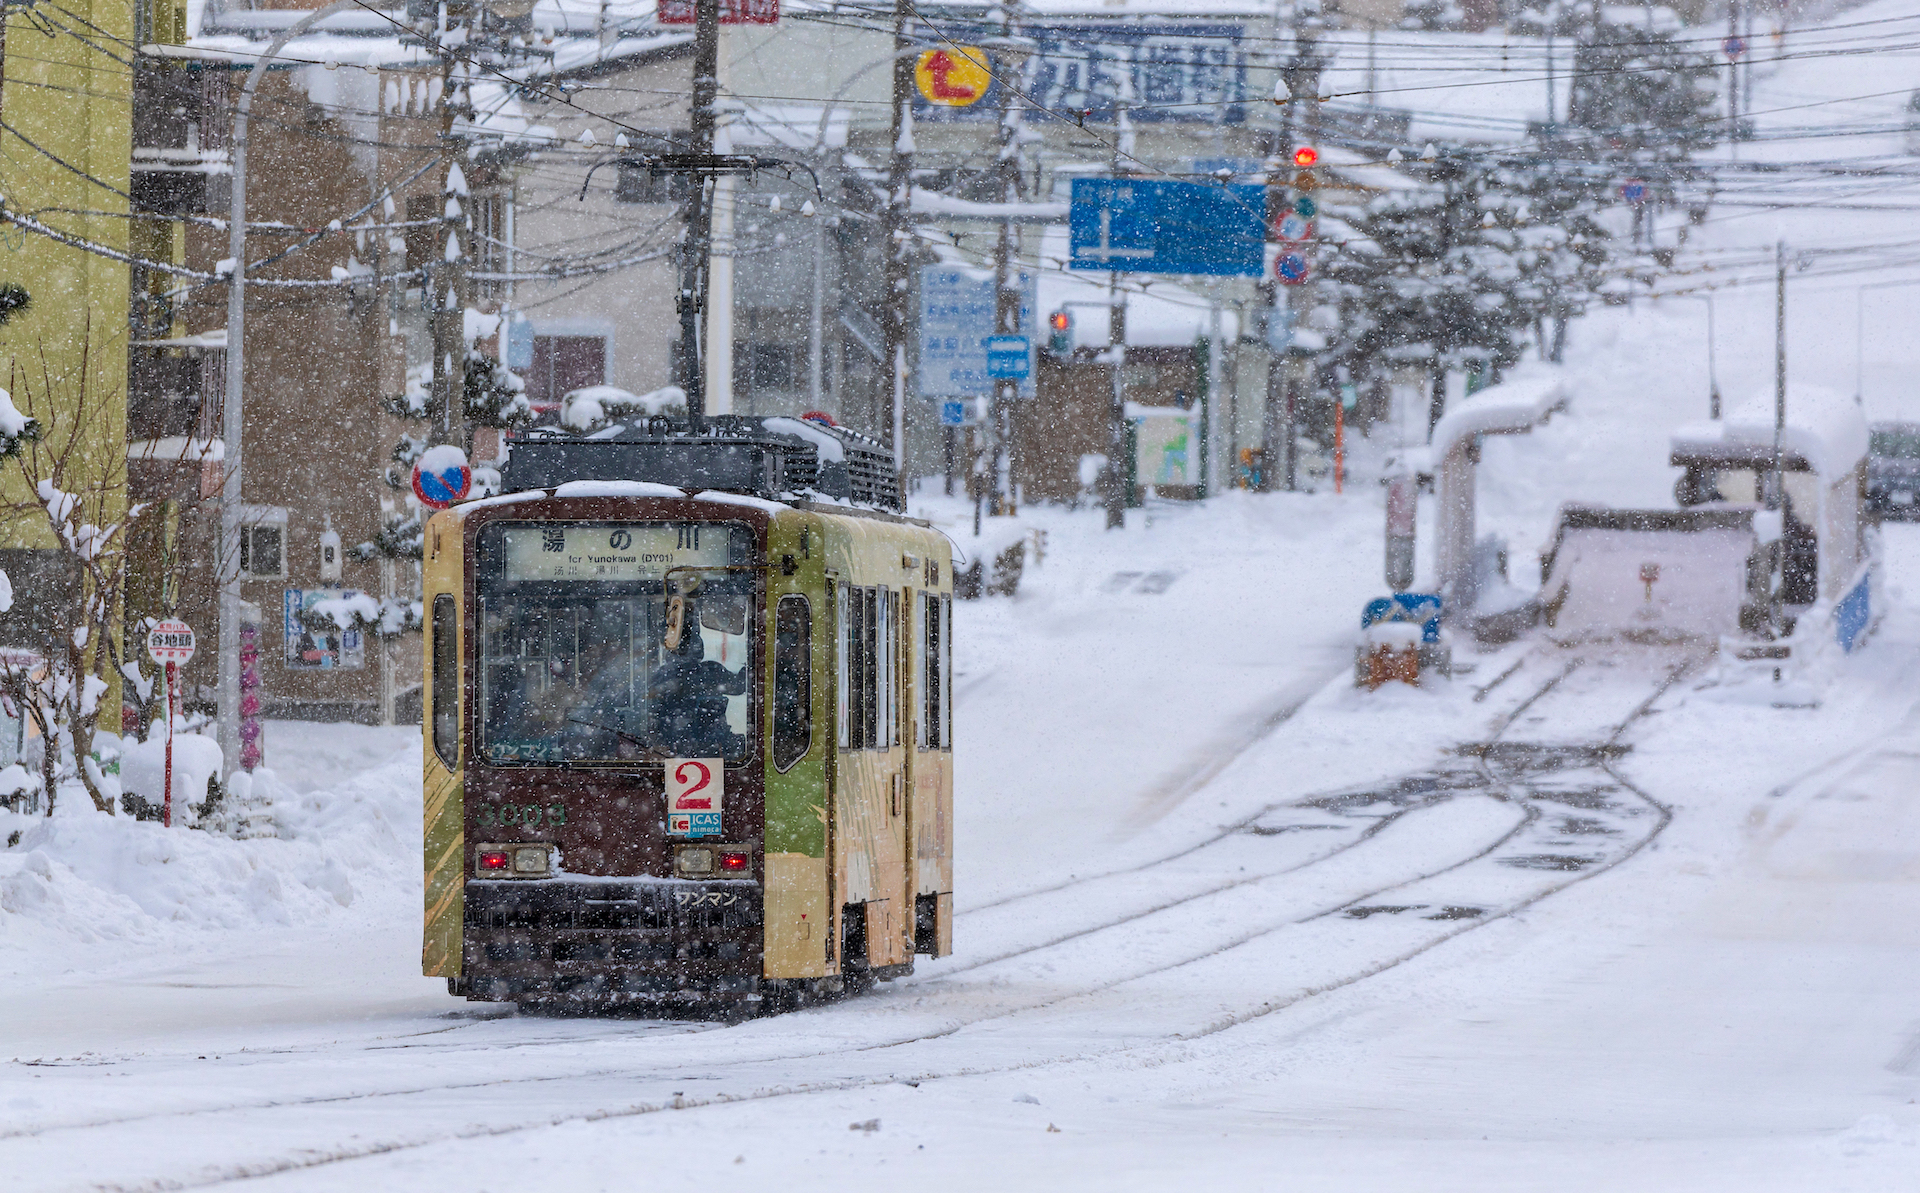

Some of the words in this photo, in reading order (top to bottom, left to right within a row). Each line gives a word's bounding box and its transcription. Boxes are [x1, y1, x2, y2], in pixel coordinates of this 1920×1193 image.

[542, 528, 699, 552] 湯の川
[568, 555, 582, 563] for
[588, 554, 636, 563] Yunokawa
[641, 553, 673, 563] (DY01)
[151, 633, 191, 647] 谷地頭
[675, 761, 711, 809] 2
[477, 803, 566, 826] 3003
[692, 814, 719, 824] ICAS
[676, 892, 737, 906] ワンマン
